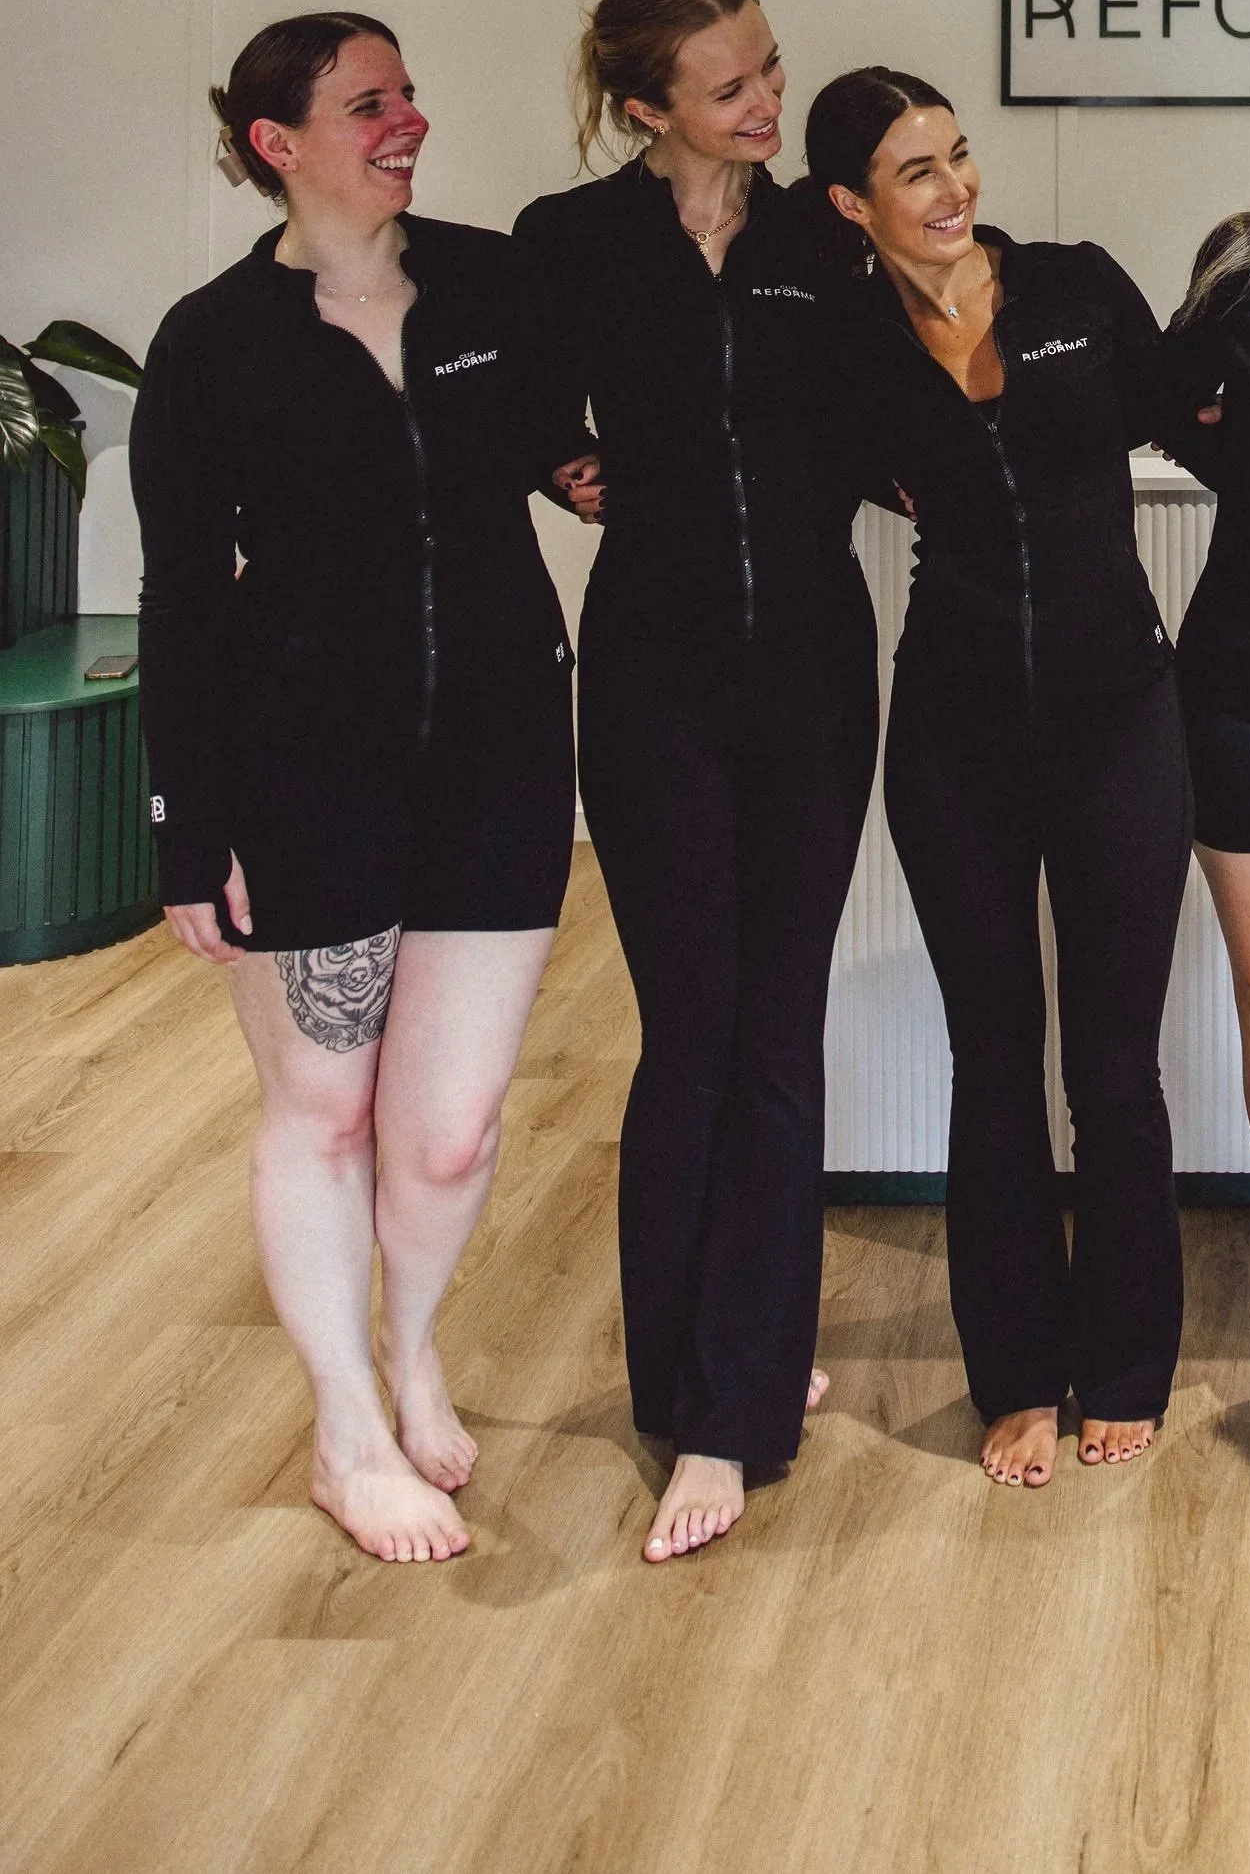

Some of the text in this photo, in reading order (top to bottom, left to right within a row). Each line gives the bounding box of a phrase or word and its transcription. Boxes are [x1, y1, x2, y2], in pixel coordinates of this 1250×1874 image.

[752, 288, 816, 303] REFORMA
[1022, 337, 1088, 362] REFORMAT
[1045, 339, 1061, 347] CLUB
[434, 349, 498, 376] REFORMAT
